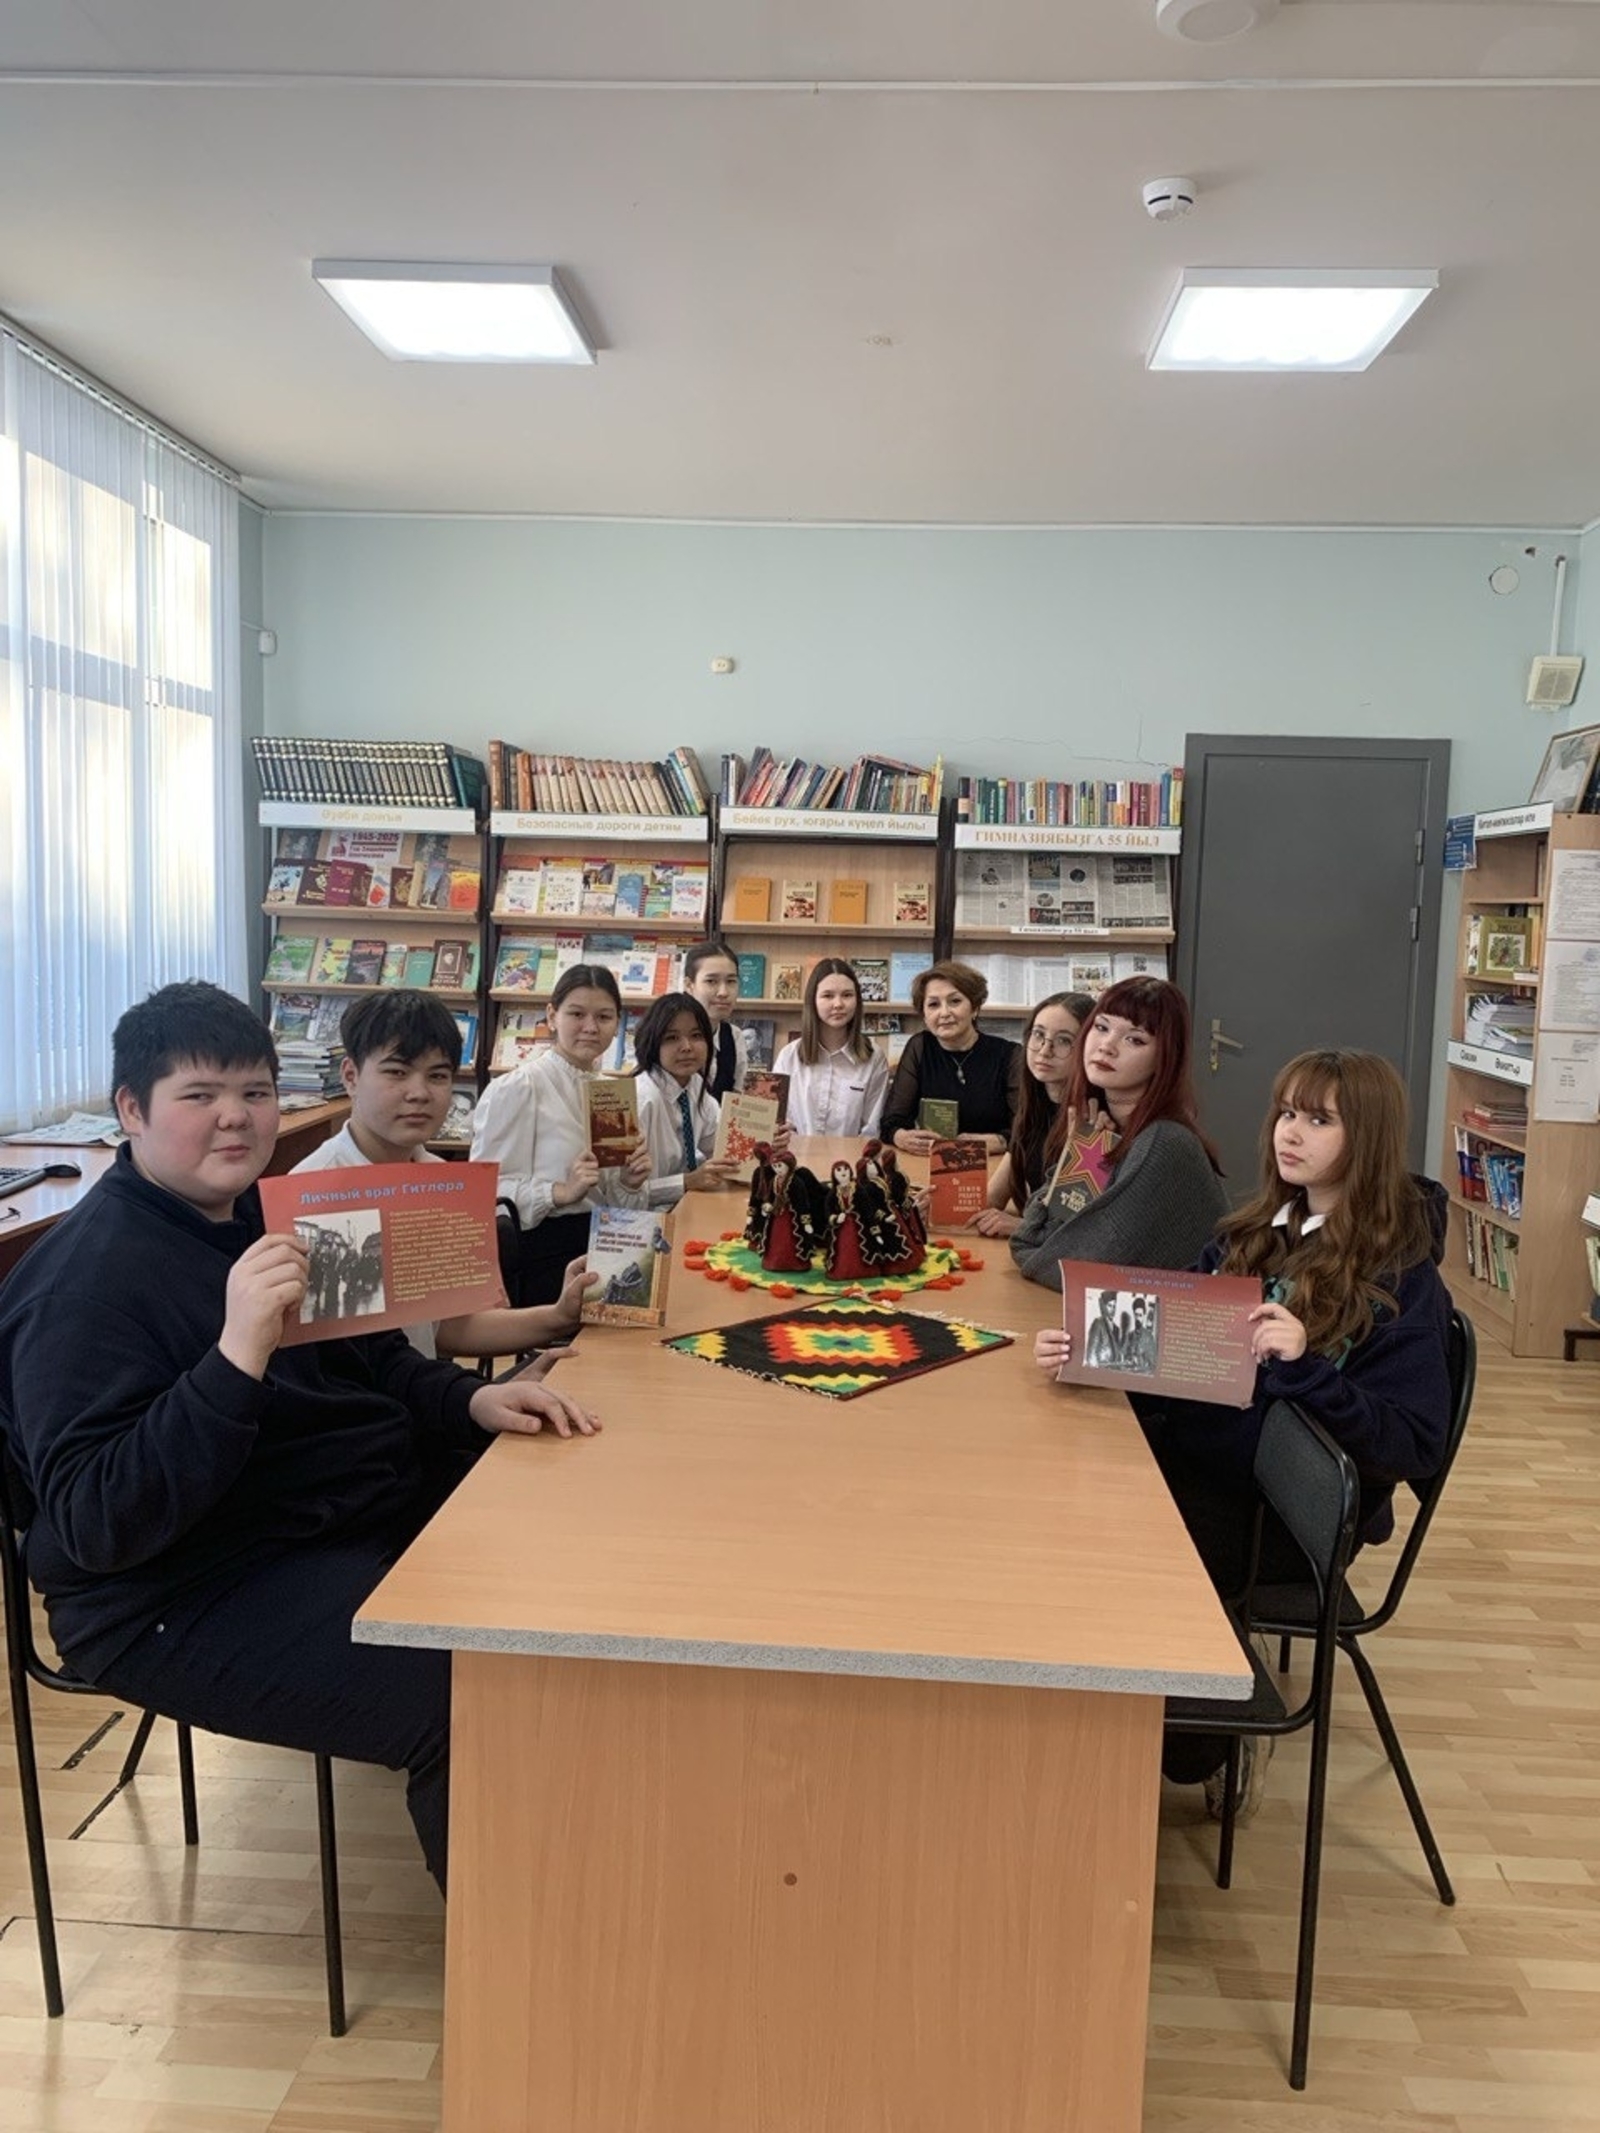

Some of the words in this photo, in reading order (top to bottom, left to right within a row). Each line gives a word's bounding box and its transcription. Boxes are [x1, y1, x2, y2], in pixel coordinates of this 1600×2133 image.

[596, 820, 640, 832] дороги
[643, 821, 682, 833] детям
[1107, 833, 1121, 846] 55
[301, 1188, 361, 1204] Личный
[365, 1185, 397, 1199] враг
[402, 1181, 465, 1195] Гитлера
